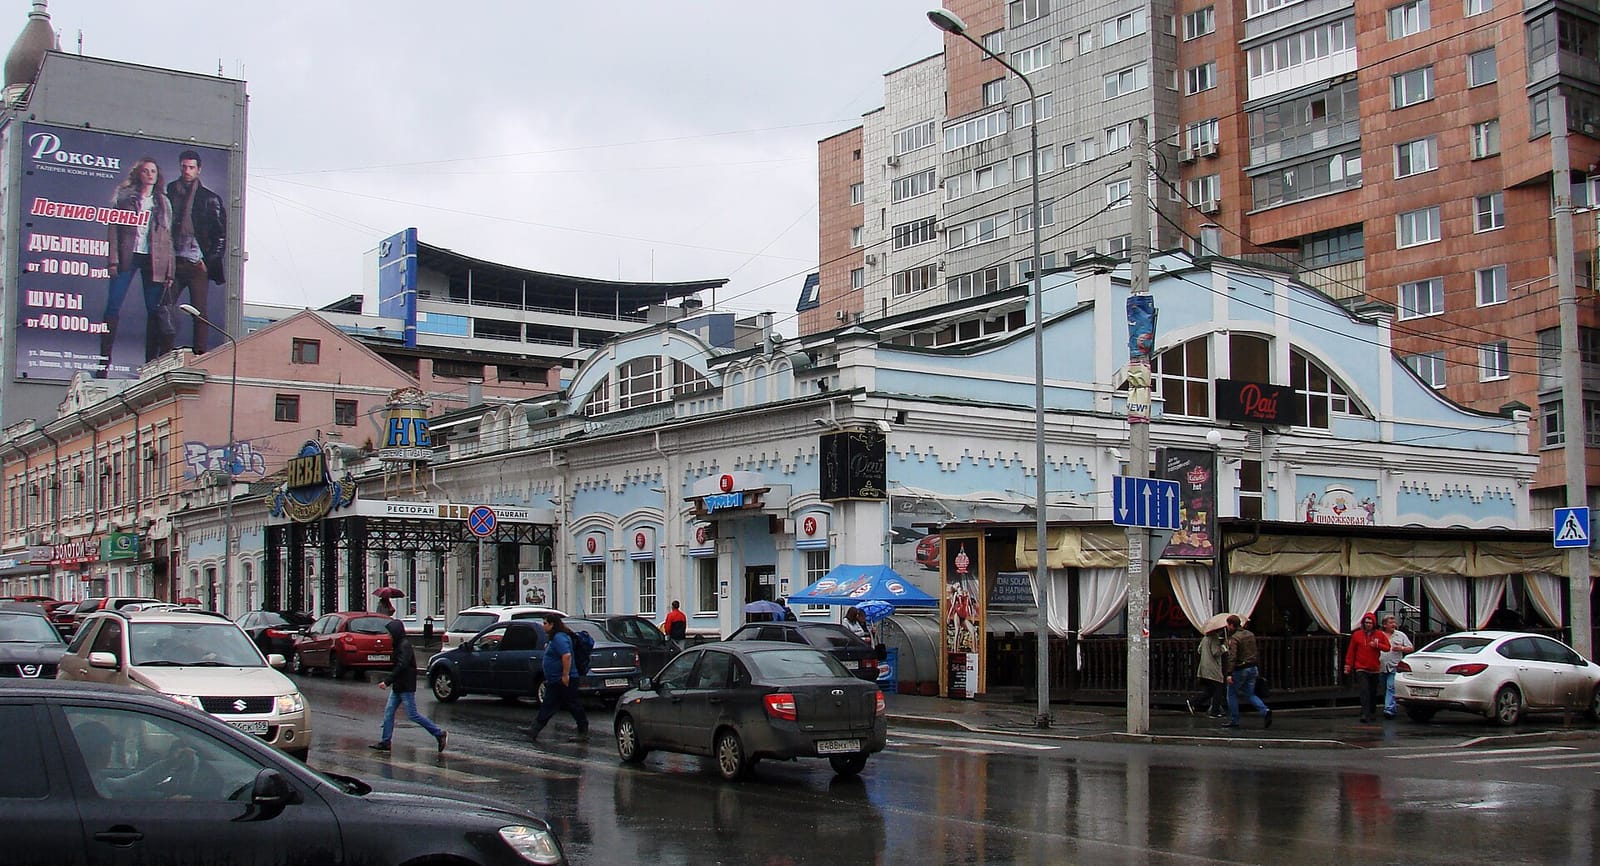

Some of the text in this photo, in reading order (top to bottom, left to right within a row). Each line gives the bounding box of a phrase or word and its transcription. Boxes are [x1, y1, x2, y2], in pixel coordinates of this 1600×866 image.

[31, 197, 151, 226] Летние цены!
[29, 233, 109, 256] ДУБЛЕНКИ
[28, 258, 111, 279] от 10 000 руб.
[28, 290, 82, 310] ШУБЫ
[27, 313, 110, 333] от 40 000 руб.
[287, 456, 322, 487] НЕВА
[387, 505, 435, 514] РЕСТОРАН
[494, 510, 528, 518] TAURANT
